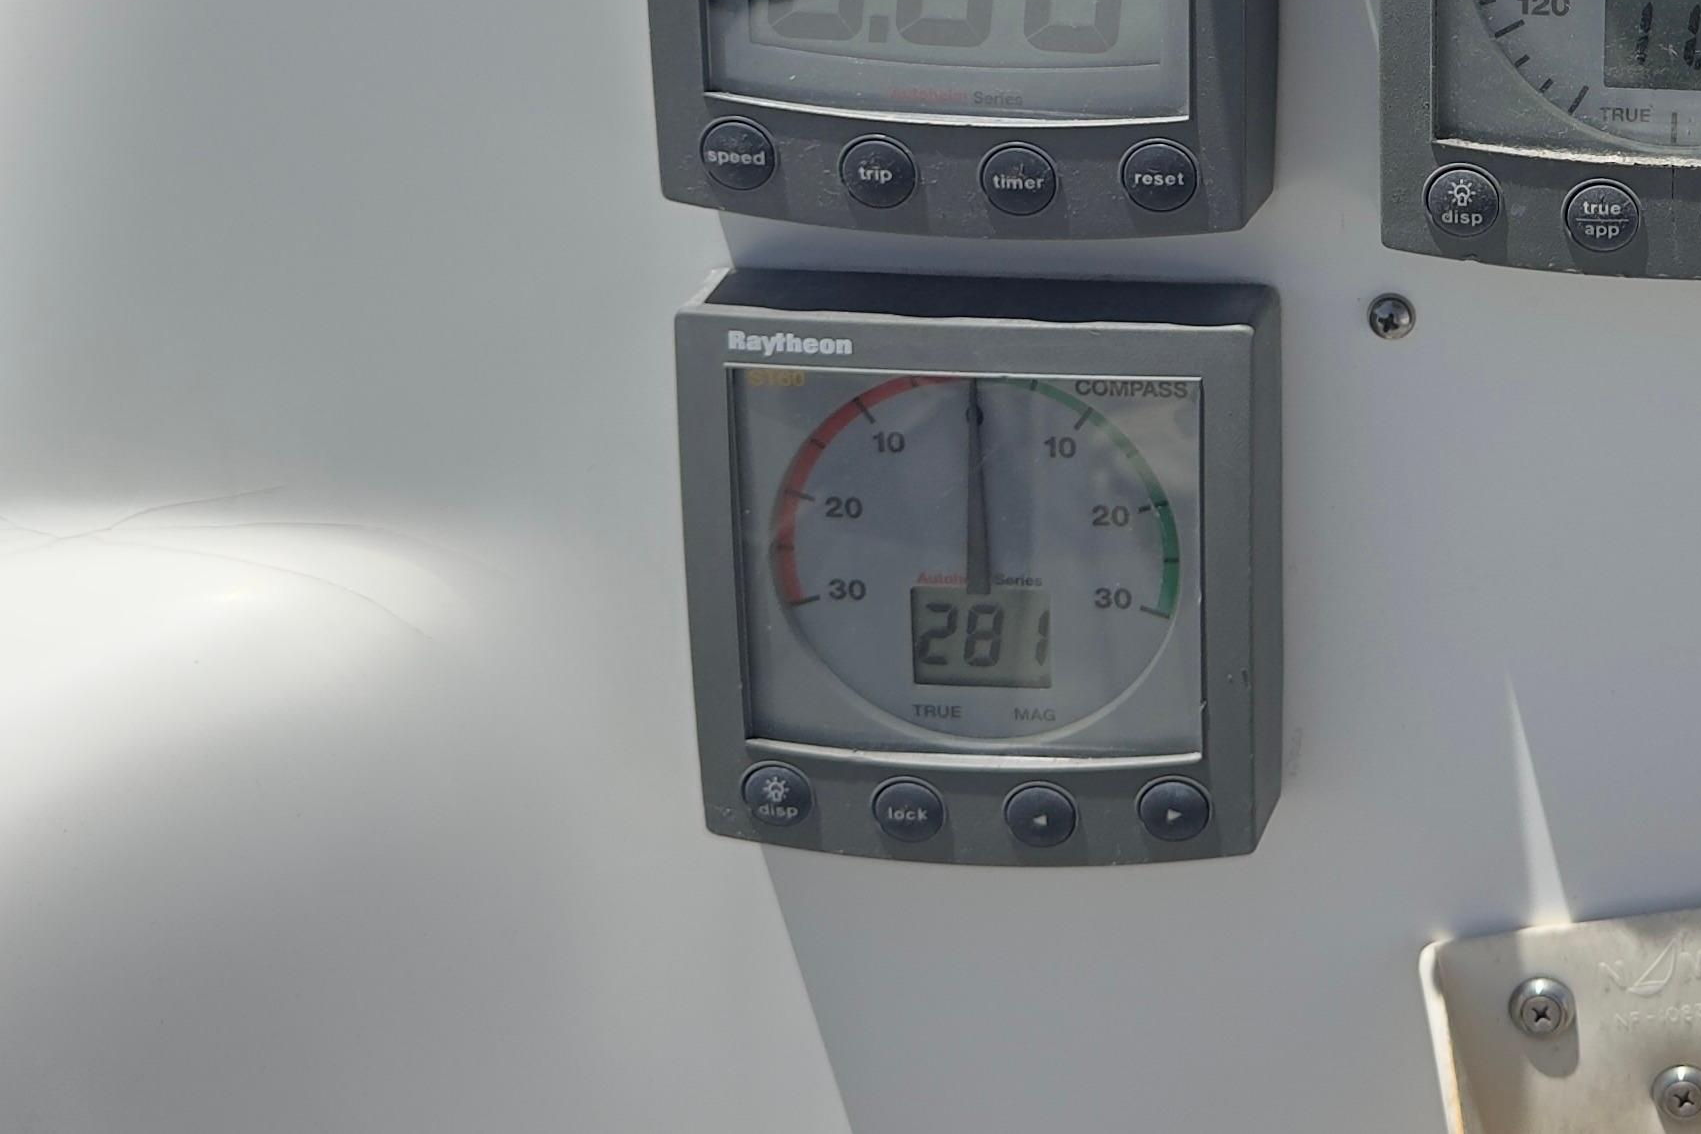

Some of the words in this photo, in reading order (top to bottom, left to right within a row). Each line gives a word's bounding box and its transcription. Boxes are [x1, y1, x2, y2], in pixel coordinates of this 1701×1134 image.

[973, 91, 1023, 106] Series
[1600, 107, 1651, 124] TRUE
[707, 148, 766, 168] speed
[858, 165, 894, 185] trip
[992, 174, 1045, 192] timer
[1133, 170, 1185, 188] reset
[1441, 209, 1484, 228] disp
[1583, 201, 1621, 217] true
[1584, 222, 1620, 240] app
[728, 330, 853, 357] Raytheon
[1075, 379, 1189, 400] COMPASS
[872, 432, 906, 455] 10
[1045, 437, 1077, 460] 10
[825, 497, 863, 519] 20
[1092, 505, 1130, 528] 20
[829, 578, 866, 602] 30
[995, 574, 1043, 587] Series
[1094, 587, 1132, 611] 30
[918, 603, 1051, 667] 281
[913, 704, 963, 719] TRUE
[1013, 707, 1057, 722] MAG
[758, 802, 799, 823] disp
[887, 806, 928, 823] lock
